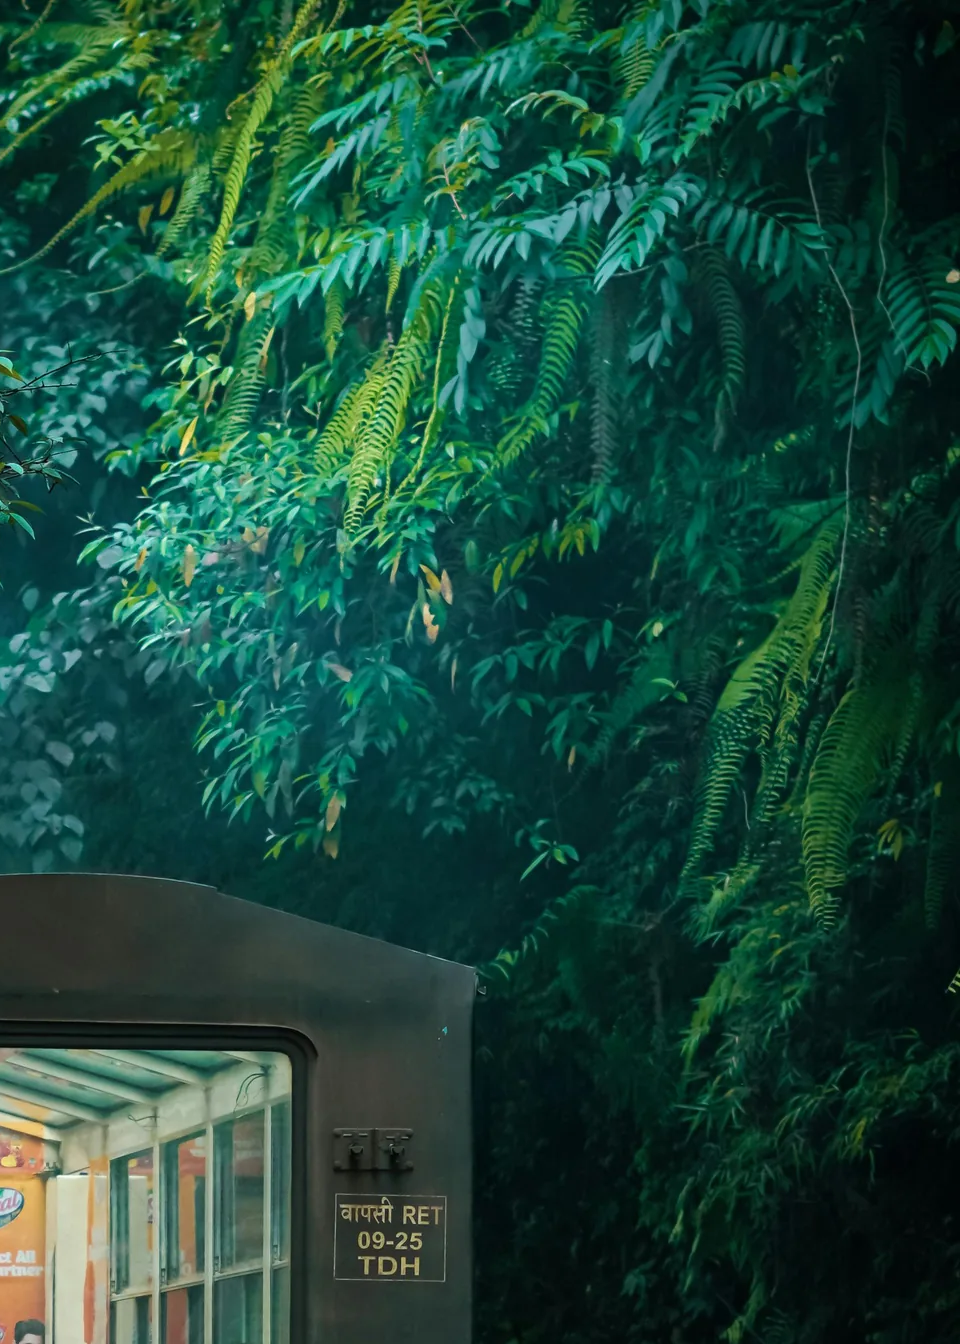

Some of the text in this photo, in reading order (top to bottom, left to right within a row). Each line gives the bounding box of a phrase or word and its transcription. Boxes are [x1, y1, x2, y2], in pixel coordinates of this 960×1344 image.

[340, 1197, 444, 1225] वापसी RET
[358, 1231, 422, 1250] 09-25
[16, 1250, 36, 1263] All
[358, 1256, 420, 1276] TDH
